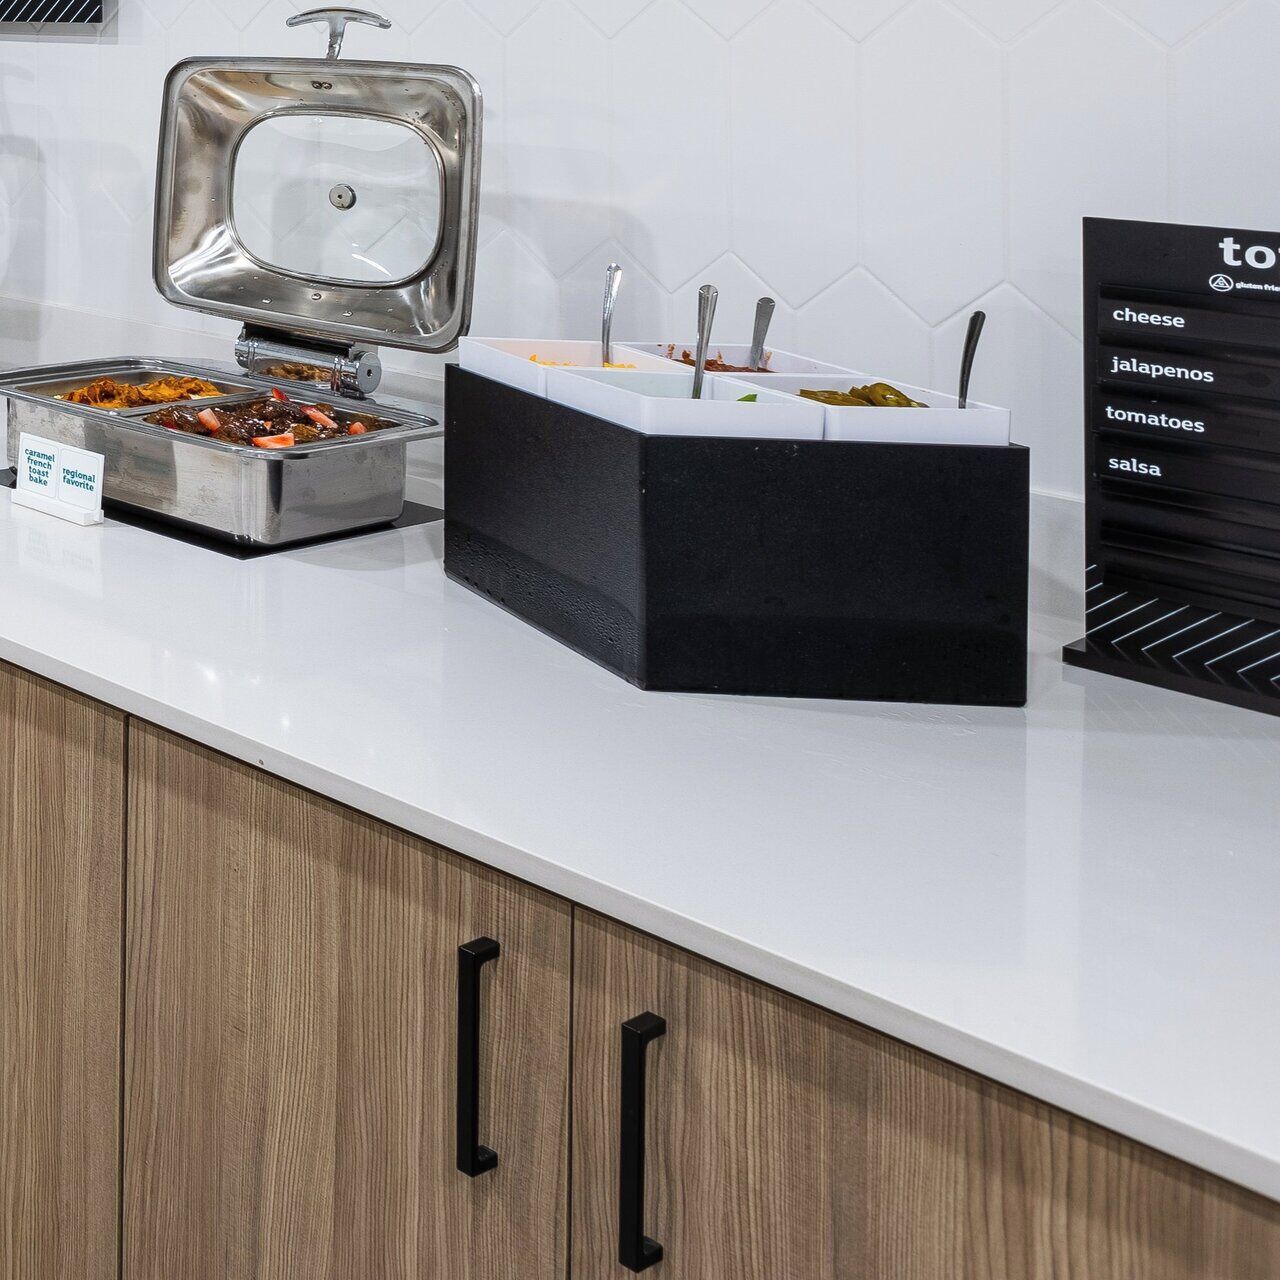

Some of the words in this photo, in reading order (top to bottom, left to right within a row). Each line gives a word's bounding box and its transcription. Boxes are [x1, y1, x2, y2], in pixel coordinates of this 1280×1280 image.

[1218, 237, 1280, 269] to
[1236, 282, 1263, 290] gluten
[1113, 308, 1185, 328] cheese
[1111, 356, 1214, 382] jalapenos
[1105, 406, 1205, 433] tomatoes
[25, 449, 55, 462] caramel
[27, 456, 52, 470] french
[29, 466, 49, 478] toast
[1109, 458, 1162, 476] salsa
[29, 474, 48, 486] bake
[62, 468, 96, 483] regional
[63, 476, 94, 492] favorite
